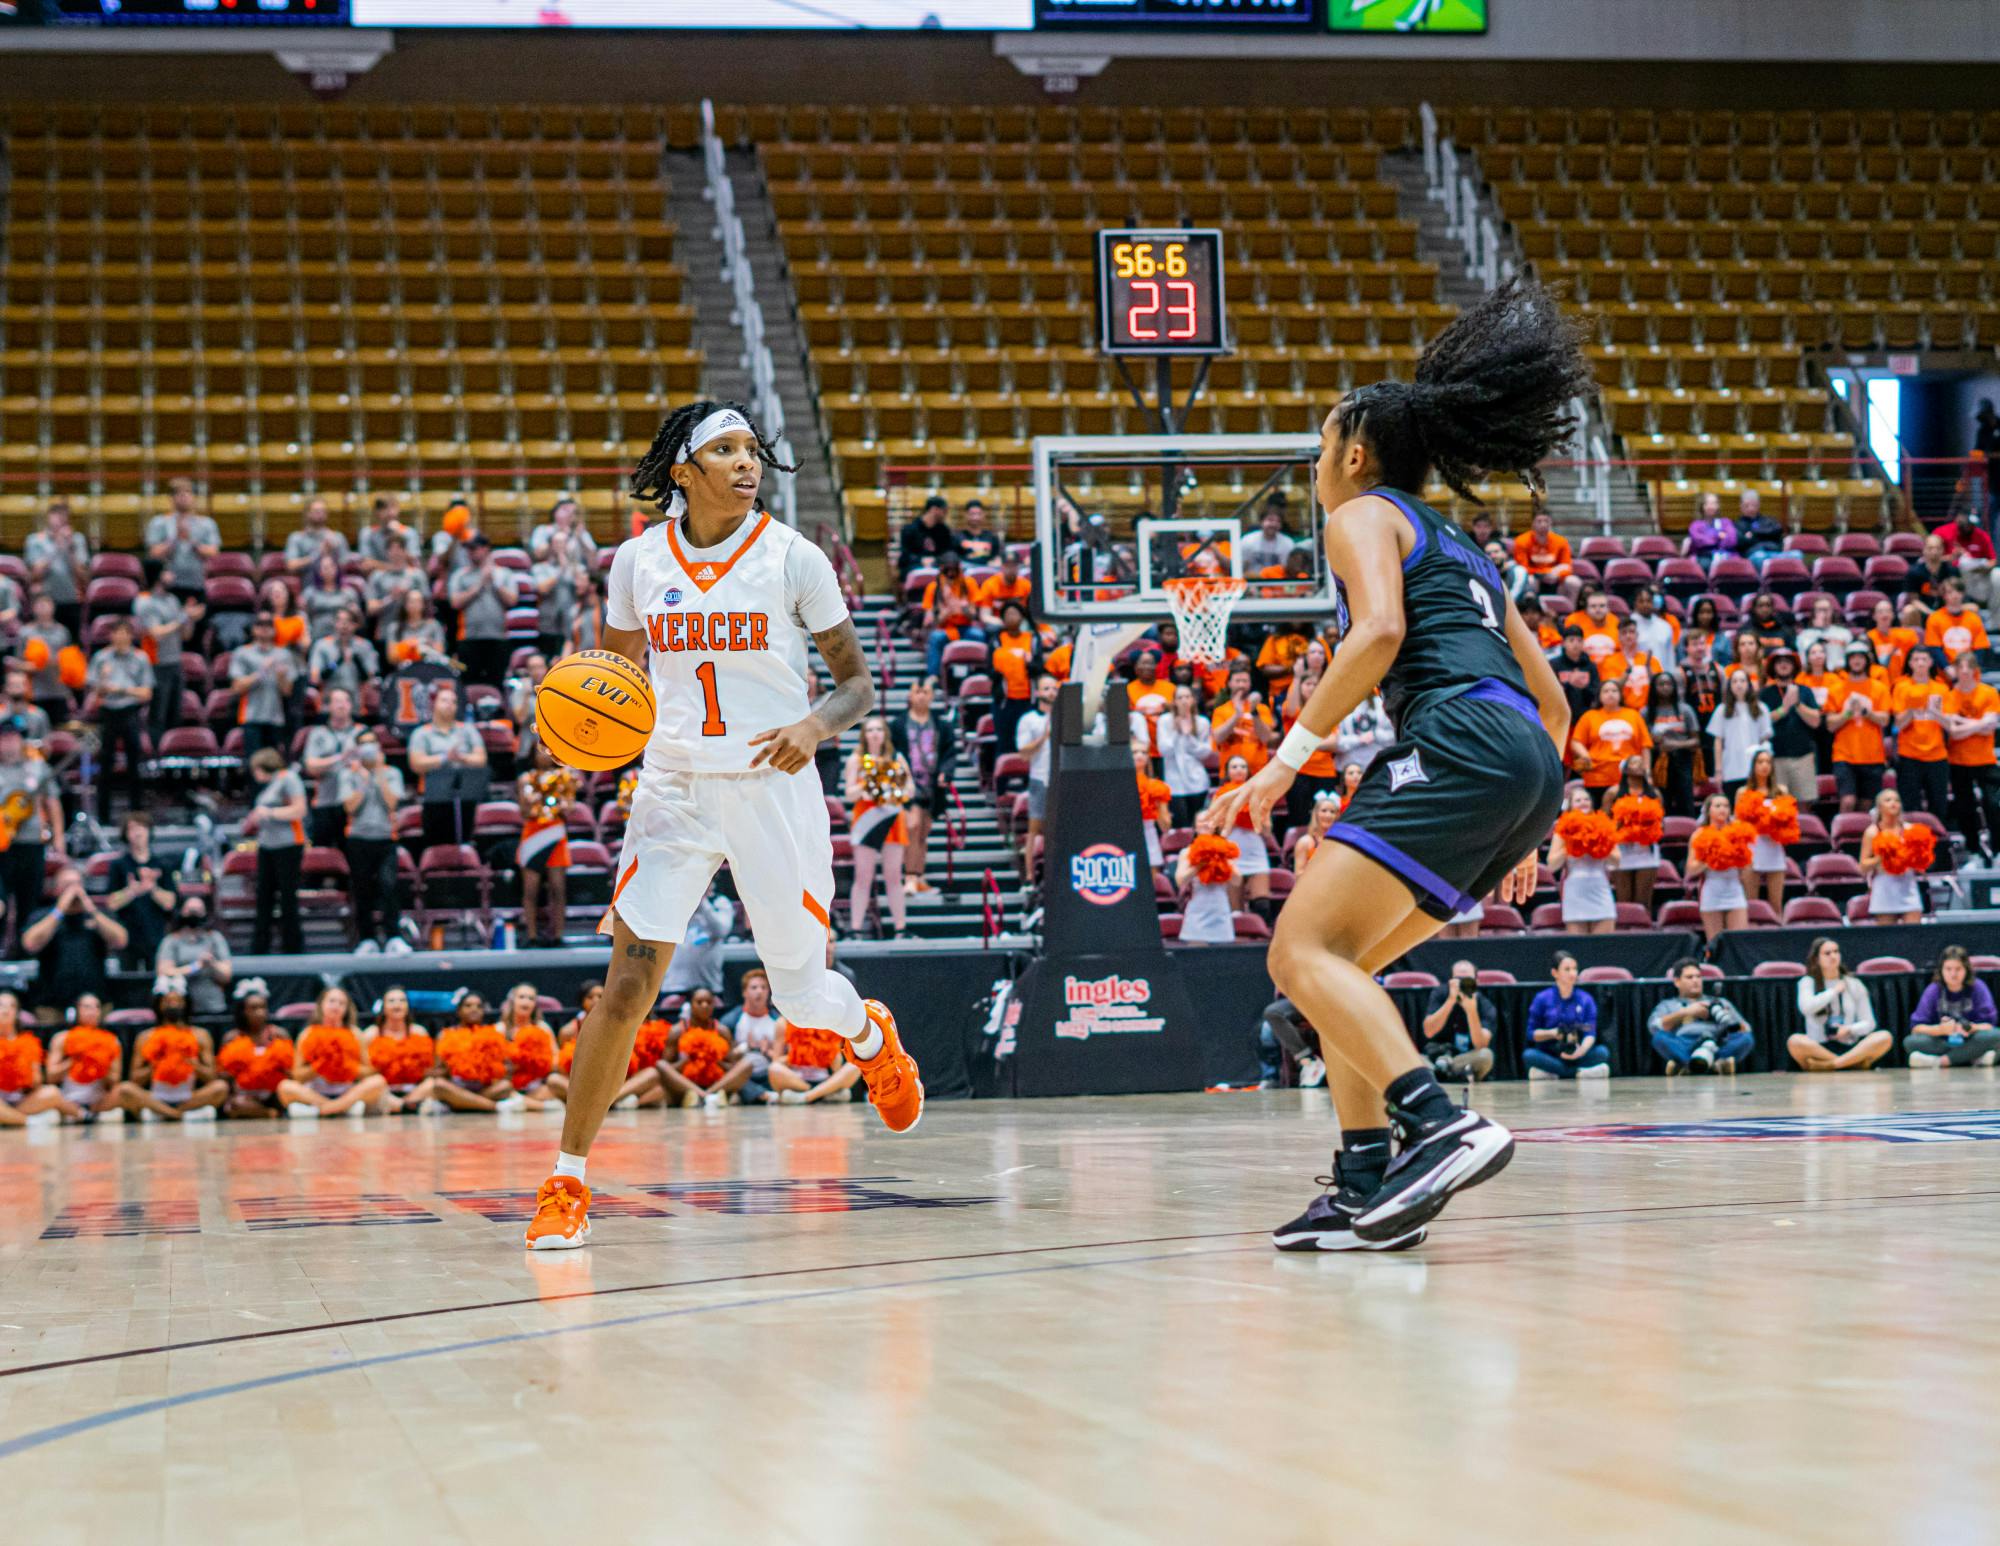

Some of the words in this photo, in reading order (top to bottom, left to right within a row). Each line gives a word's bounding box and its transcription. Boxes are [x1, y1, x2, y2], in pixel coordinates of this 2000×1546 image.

[1113, 243, 1187, 278] 56.6
[1128, 281, 1196, 338] 23
[647, 612, 769, 653] MERCER
[581, 676, 631, 706] EVO
[695, 661, 727, 737] 1
[1072, 854, 1135, 890] SOCON
[1066, 976, 1150, 1006] ingles
